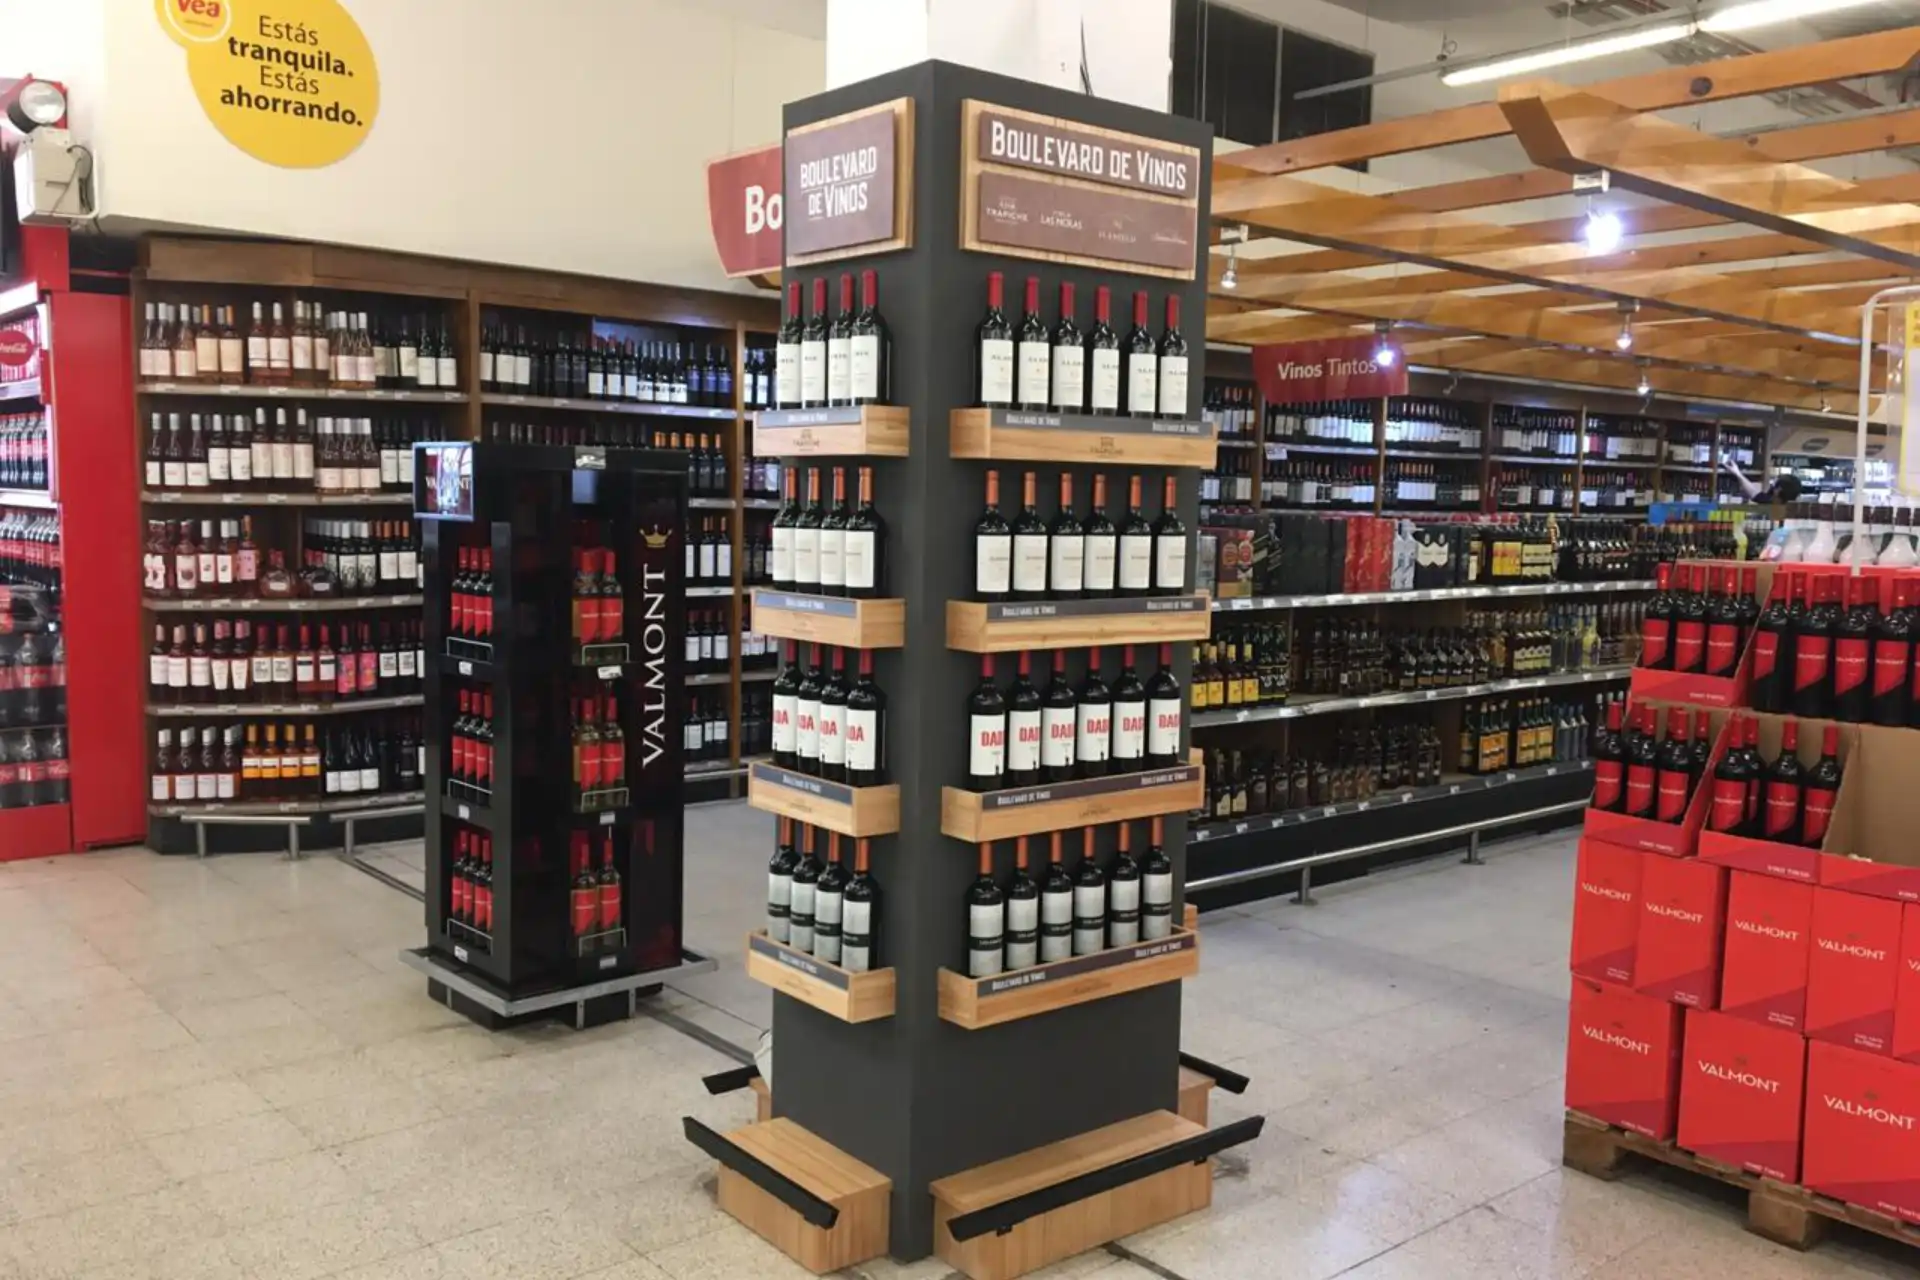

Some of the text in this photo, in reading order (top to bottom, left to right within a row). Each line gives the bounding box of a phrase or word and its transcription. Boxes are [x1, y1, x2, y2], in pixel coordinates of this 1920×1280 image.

[259, 15, 319, 46] Estás
[228, 36, 354, 77] tranquila.
[260, 64, 320, 95] Estás
[220, 85, 363, 127] ahorrando.
[800, 146, 877, 188] BOULEVARD
[808, 181, 868, 218] DE VINOS
[1278, 358, 1378, 381] Vinos Tintos
[643, 563, 666, 769] VALMONT
[1581, 881, 1632, 902] VALMONT
[1645, 902, 1704, 923] VALMONT
[1735, 919, 1800, 941] VALMONT
[1817, 937, 1886, 961] VALMONT
[1582, 1022, 1652, 1055] VALMONT
[1698, 1060, 1780, 1094] VALMONT
[1823, 1094, 1917, 1130] VALMONT
